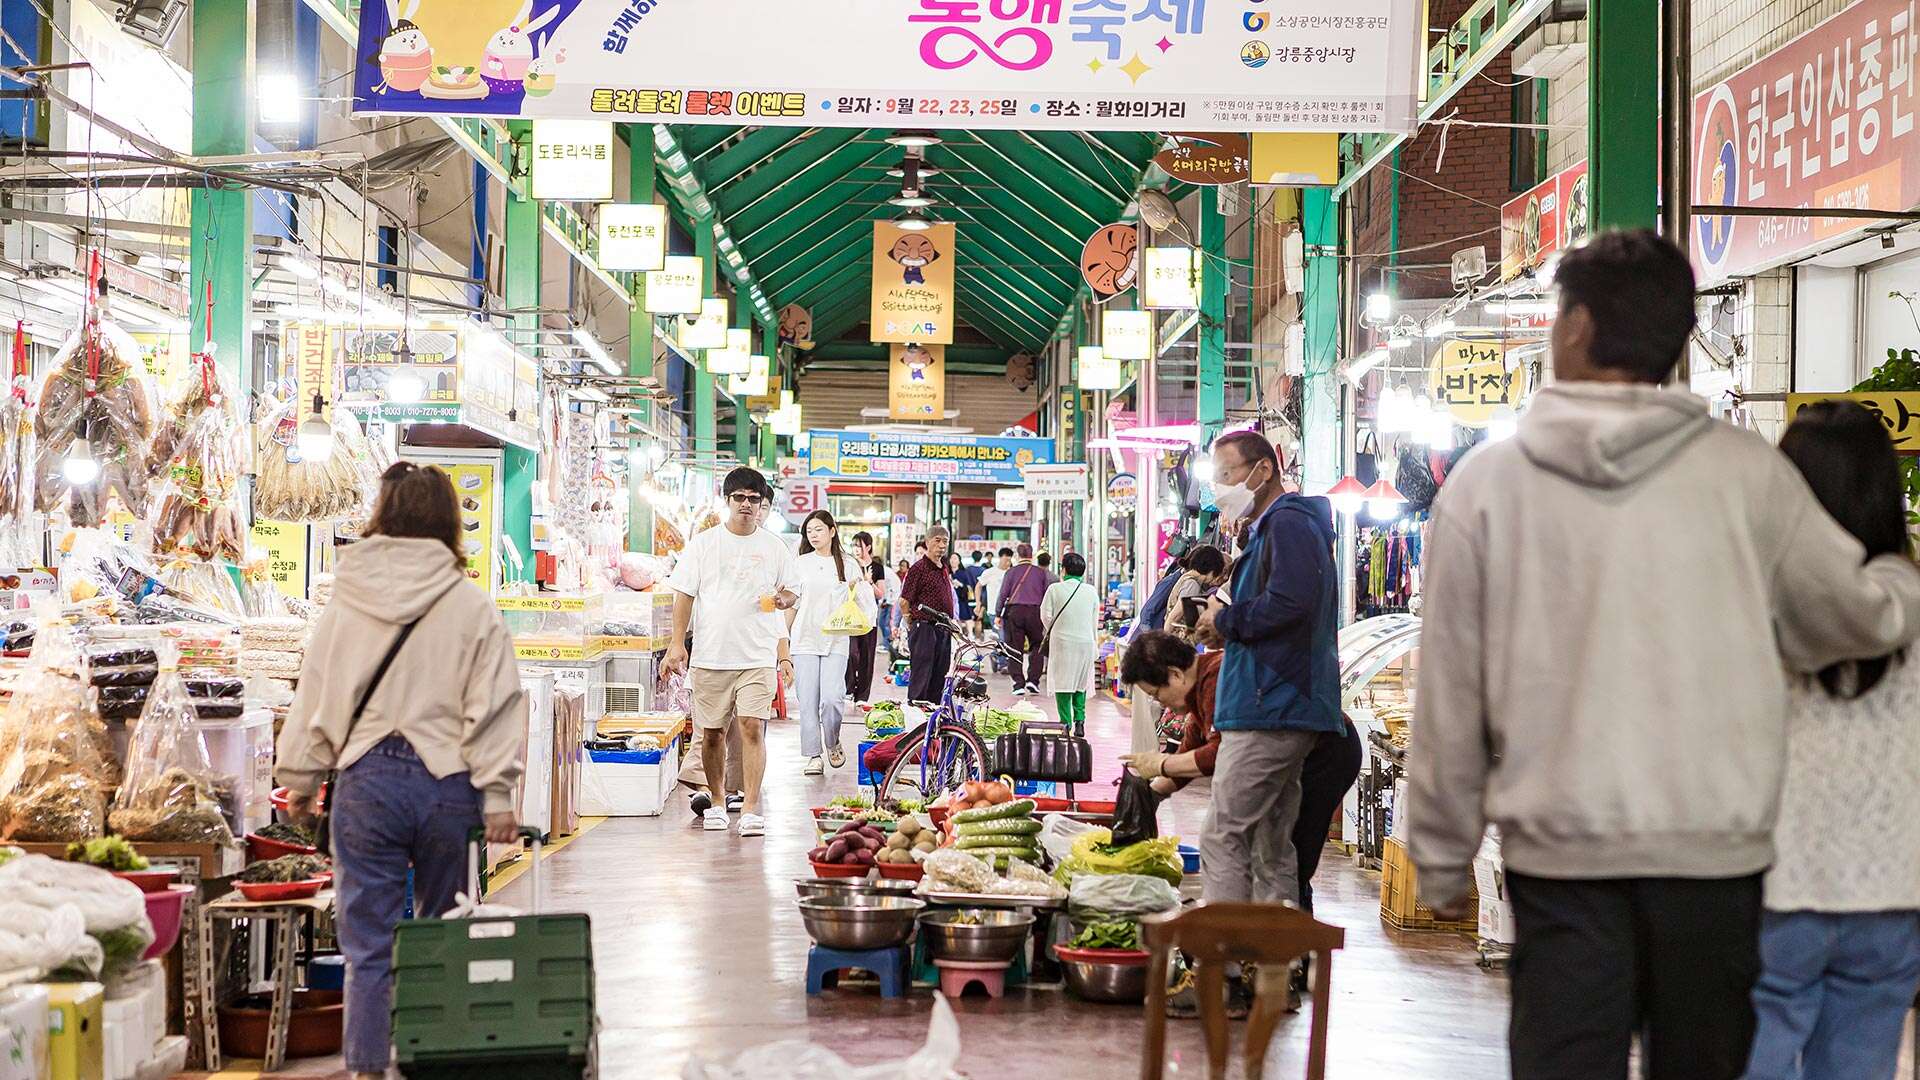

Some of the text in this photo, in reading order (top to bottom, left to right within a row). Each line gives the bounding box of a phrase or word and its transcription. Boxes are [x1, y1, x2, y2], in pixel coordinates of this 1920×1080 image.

[1276, 16, 1388, 29] 소상공인시장진흥공단
[1275, 47, 1356, 63] 강릉중앙시장
[591, 88, 805, 116] 돌려돌려 룰렛 이벤트
[837, 97, 872, 114] 일자
[885, 98, 914, 115] 9월
[918, 99, 944, 116] 22,
[949, 100, 974, 117] 23,
[979, 99, 1017, 116] 25일
[1046, 100, 1080, 117] 장소
[1096, 100, 1186, 118] 월화의거리
[1237, 102, 1254, 111] 이상
[1256, 102, 1273, 111] 구입
[1302, 102, 1319, 111] 소지
[1747, 9, 1919, 202] 한국인삼총판
[539, 144, 605, 159] 도토리식품
[1173, 157, 1232, 173] 소머리국밥
[882, 301, 942, 313] Sisittakttagi
[1446, 372, 1512, 405] 반찬
[841, 441, 879, 456] 우리동네
[880, 442, 920, 458] 단골시장!
[921, 444, 976, 459] 카카오톡에서
[788, 485, 818, 513] 회
[256, 526, 280, 536] 막국수
[272, 561, 297, 571] 수정과
[521, 600, 549, 608] 수제돈가스
[519, 649, 548, 657] 수제돈가스
